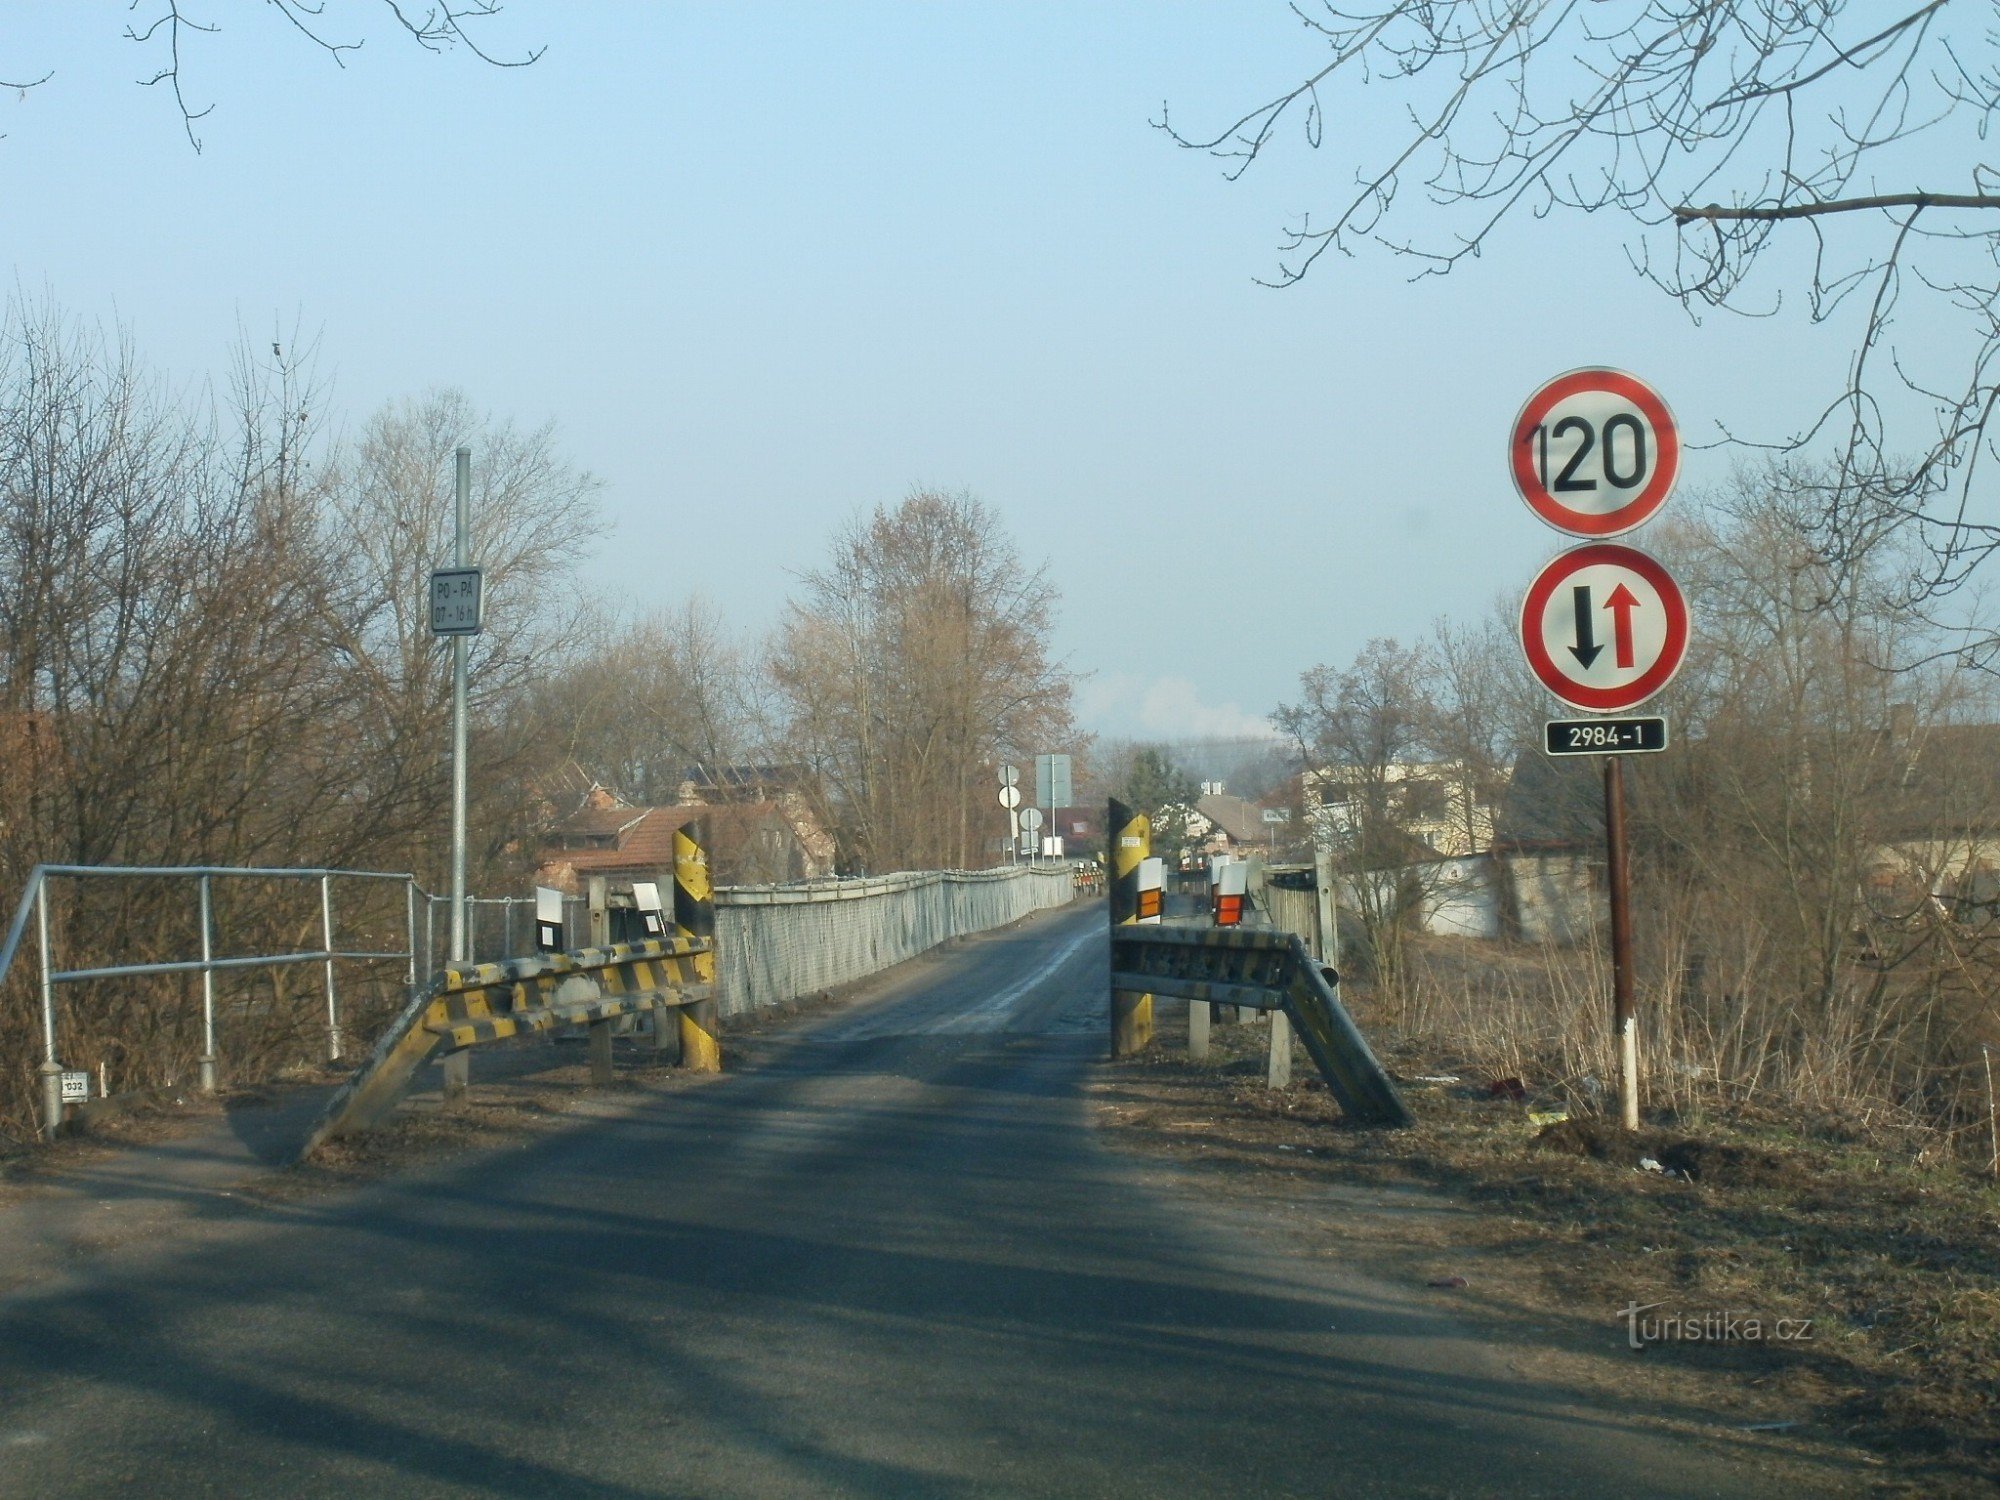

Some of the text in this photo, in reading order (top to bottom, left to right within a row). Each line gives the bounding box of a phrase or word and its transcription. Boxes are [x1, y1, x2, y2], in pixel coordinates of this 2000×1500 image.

[1523, 413, 1647, 493] 120
[437, 582, 450, 599] PO
[1569, 725, 1643, 747] 2984-1
